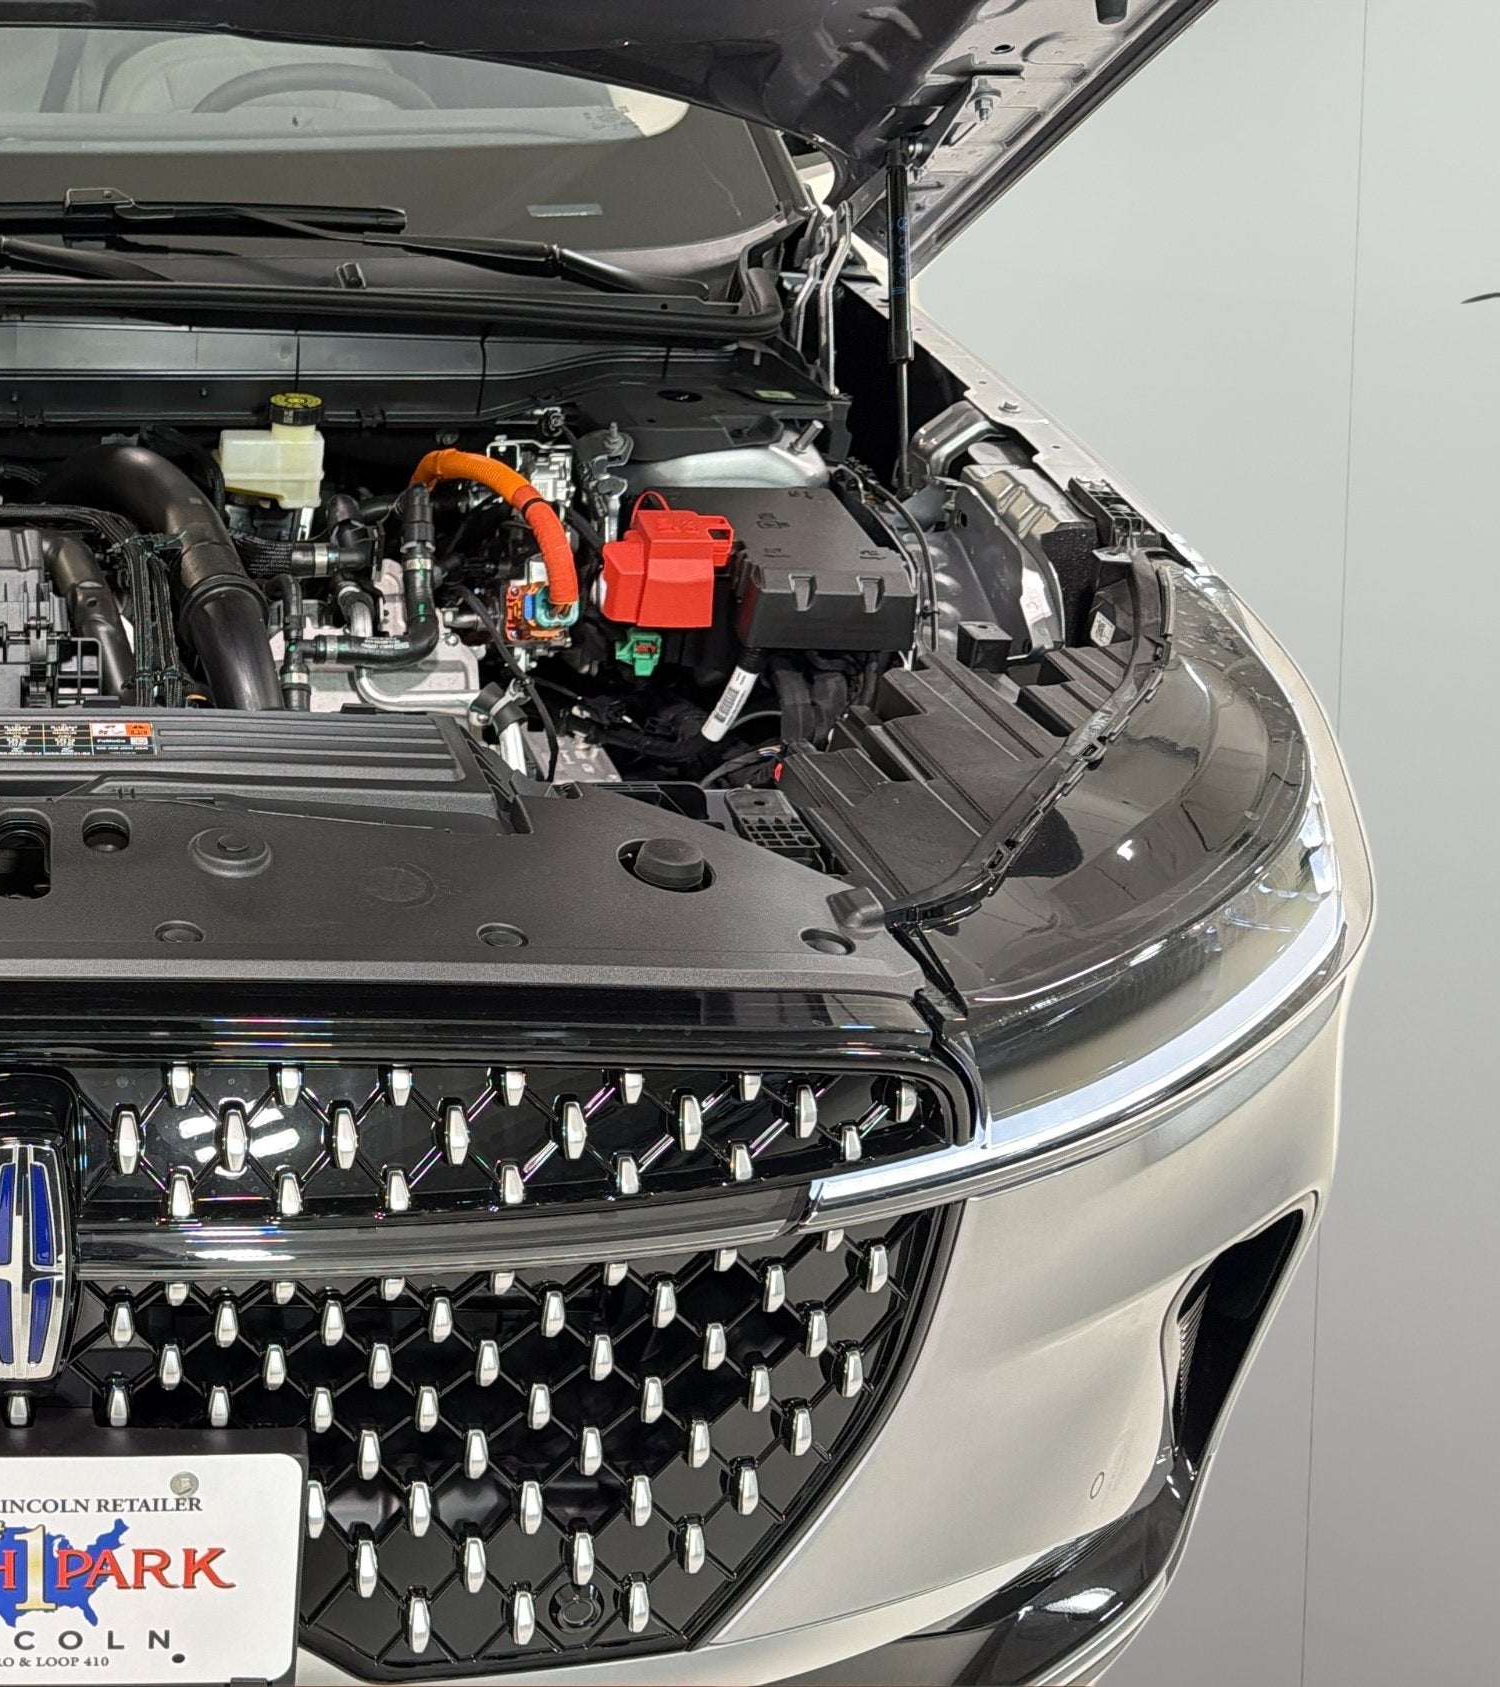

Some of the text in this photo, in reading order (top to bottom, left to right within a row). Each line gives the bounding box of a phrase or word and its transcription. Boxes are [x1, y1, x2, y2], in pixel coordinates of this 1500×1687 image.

[95, 1497, 203, 1513] RETAILER
[55, 1547, 237, 1591] PARK
[19, 1656, 32, 1667] &
[36, 1656, 80, 1667] LOOP
[84, 1656, 110, 1667] 410
